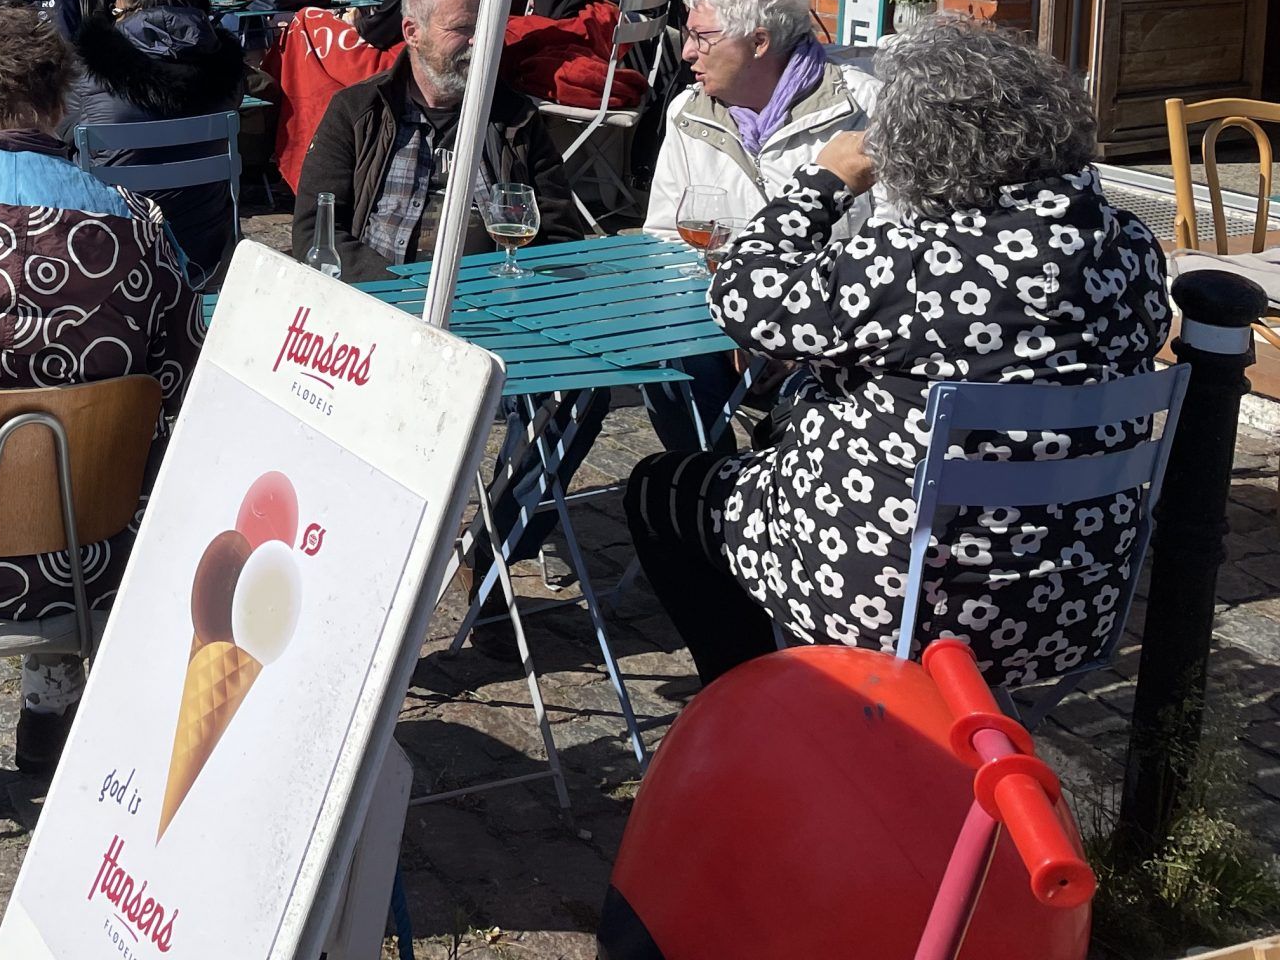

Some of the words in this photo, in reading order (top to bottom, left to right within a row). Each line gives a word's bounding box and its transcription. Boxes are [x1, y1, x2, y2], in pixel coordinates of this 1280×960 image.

[272, 306, 377, 386] Hansens
[290, 381, 334, 416] FLØDEIS
[98, 768, 136, 805] god
[127, 788, 142, 815] is
[87, 834, 179, 953] Hansens
[103, 918, 137, 960] FLØDEI
